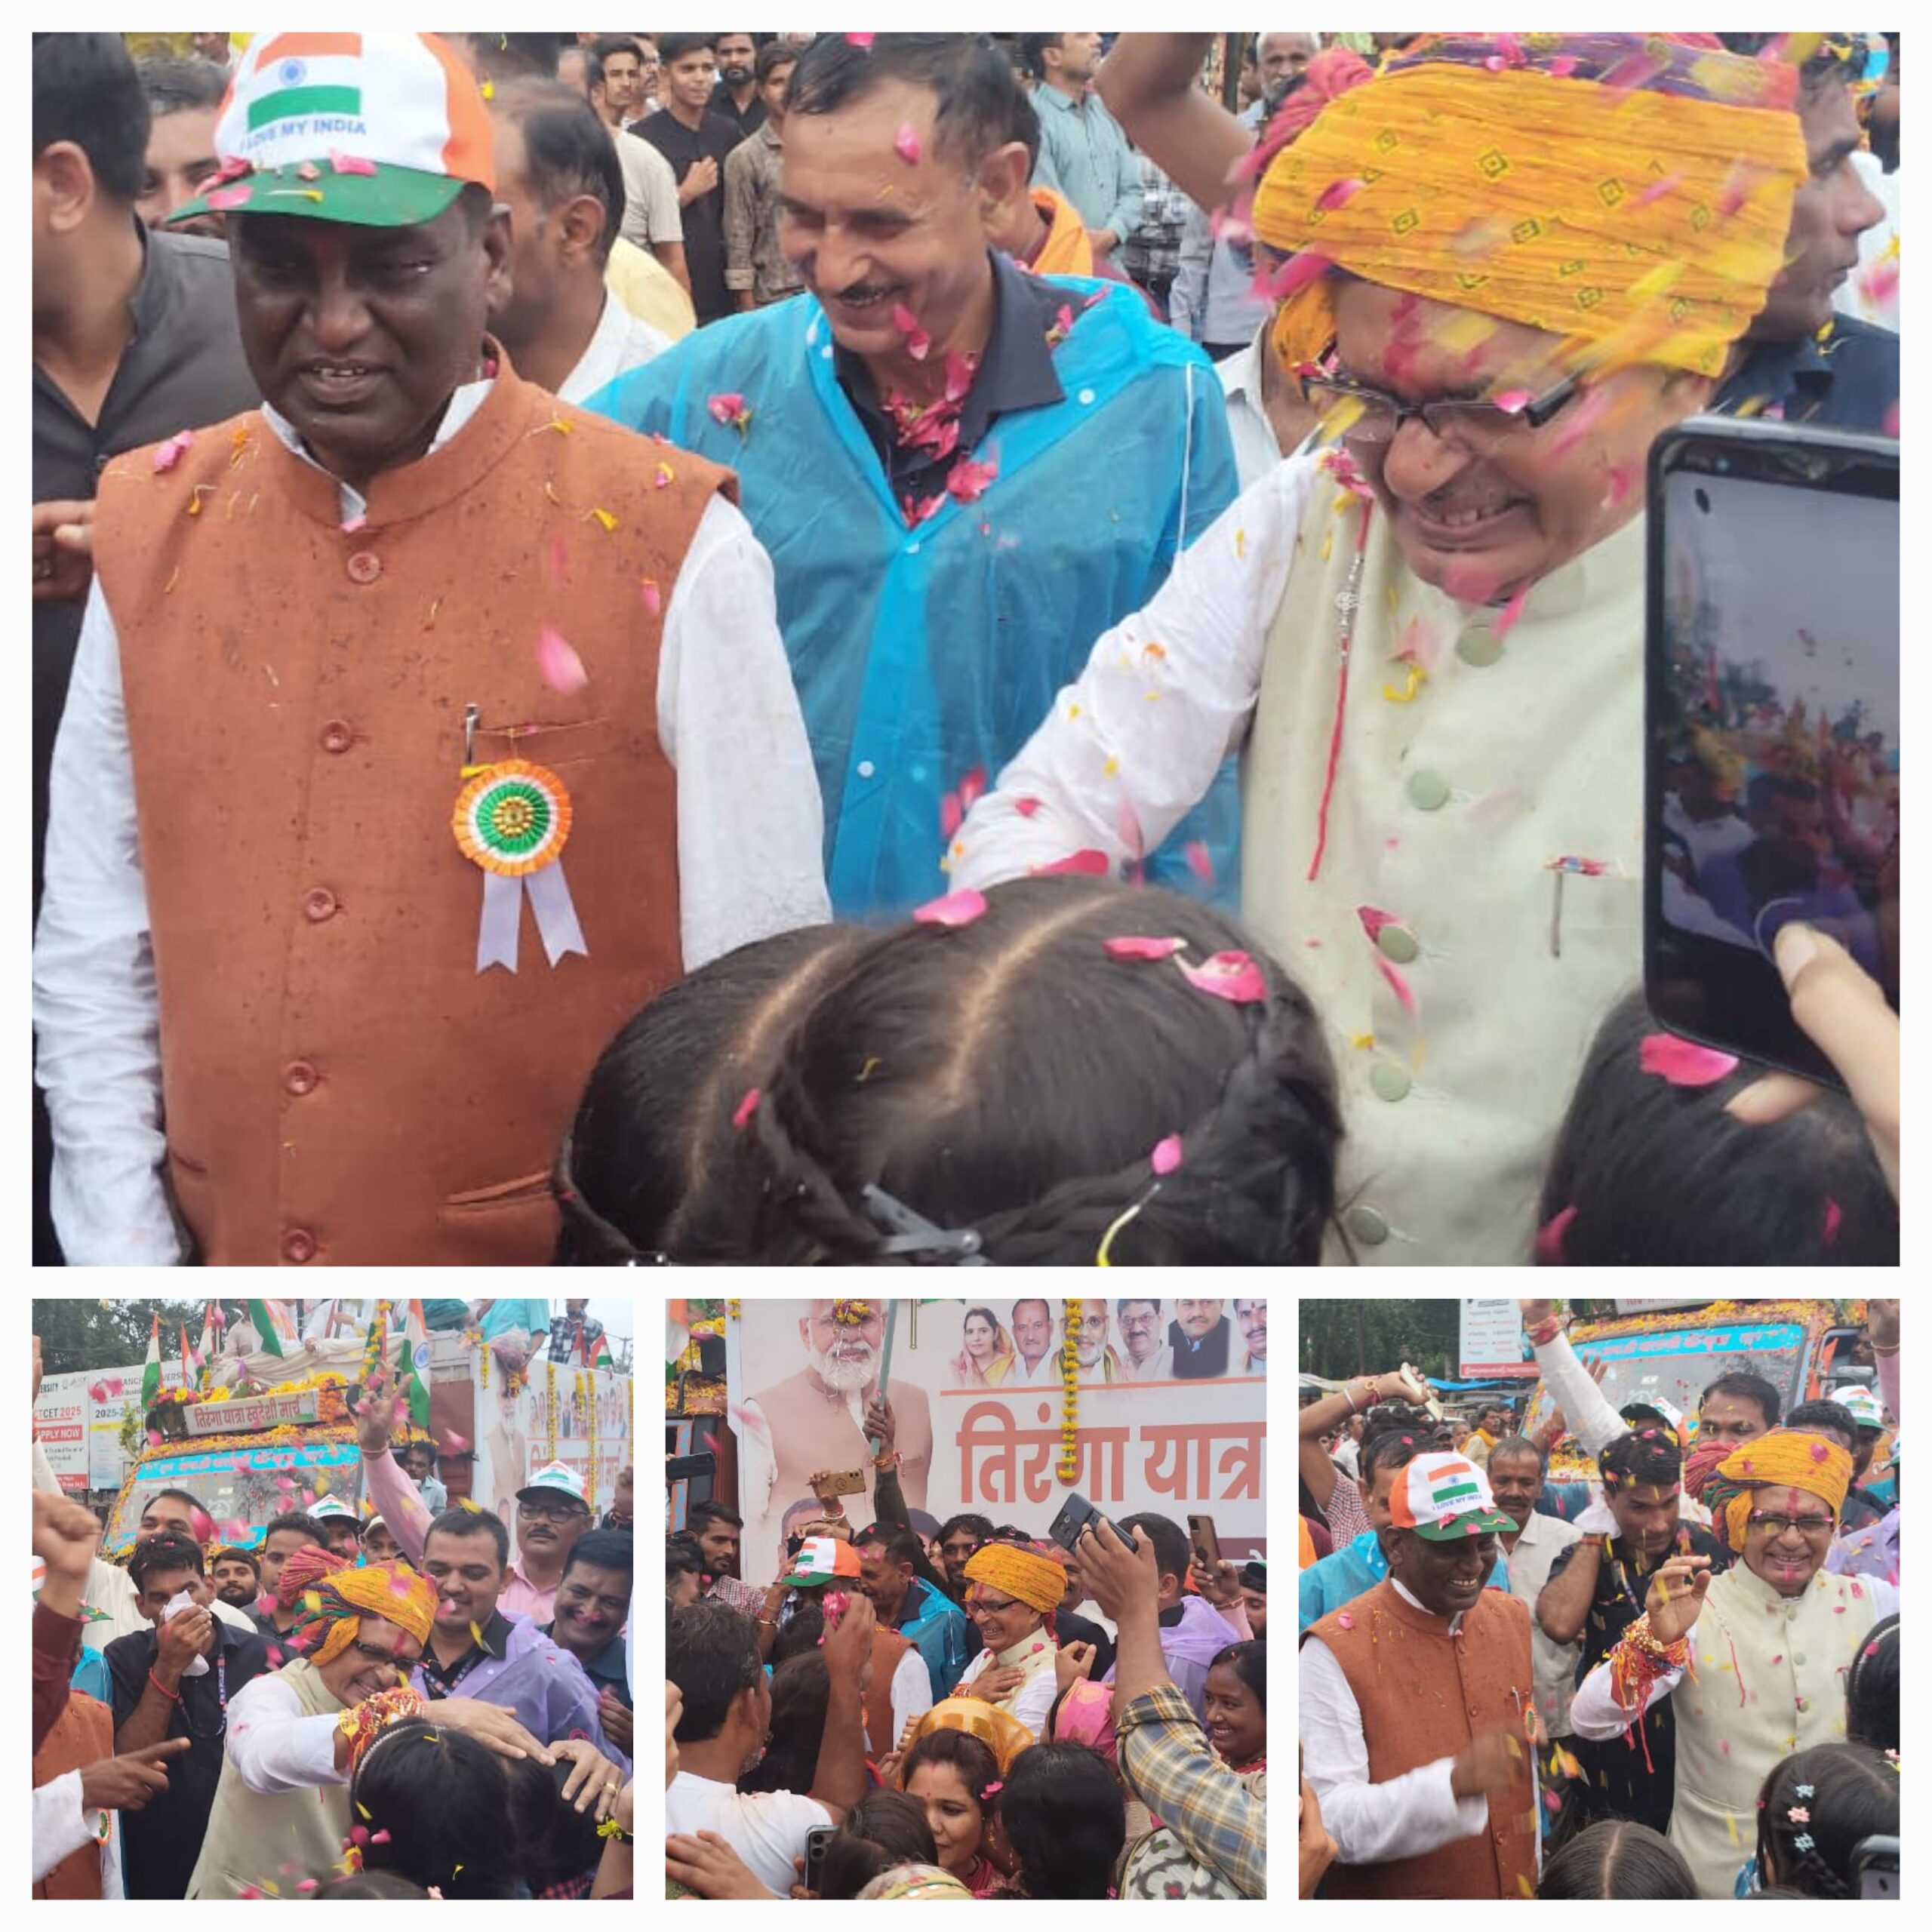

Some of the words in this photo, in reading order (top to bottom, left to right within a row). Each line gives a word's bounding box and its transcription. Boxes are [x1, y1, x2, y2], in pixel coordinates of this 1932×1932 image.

[281, 120, 309, 137] MY
[313, 119, 367, 135] INDIA
[60, 1406, 82, 1417] 2025
[195, 1406, 223, 1429] तिरंगा
[223, 1407, 245, 1426] यात्रा
[278, 1395, 302, 1419] मार्च
[38, 1429, 60, 1439] PPLY
[61, 1428, 81, 1438] NOW
[956, 1401, 1130, 1503] तिरंगा
[1140, 1422, 1267, 1500] यात्र
[1436, 1500, 1454, 1509] LOVE
